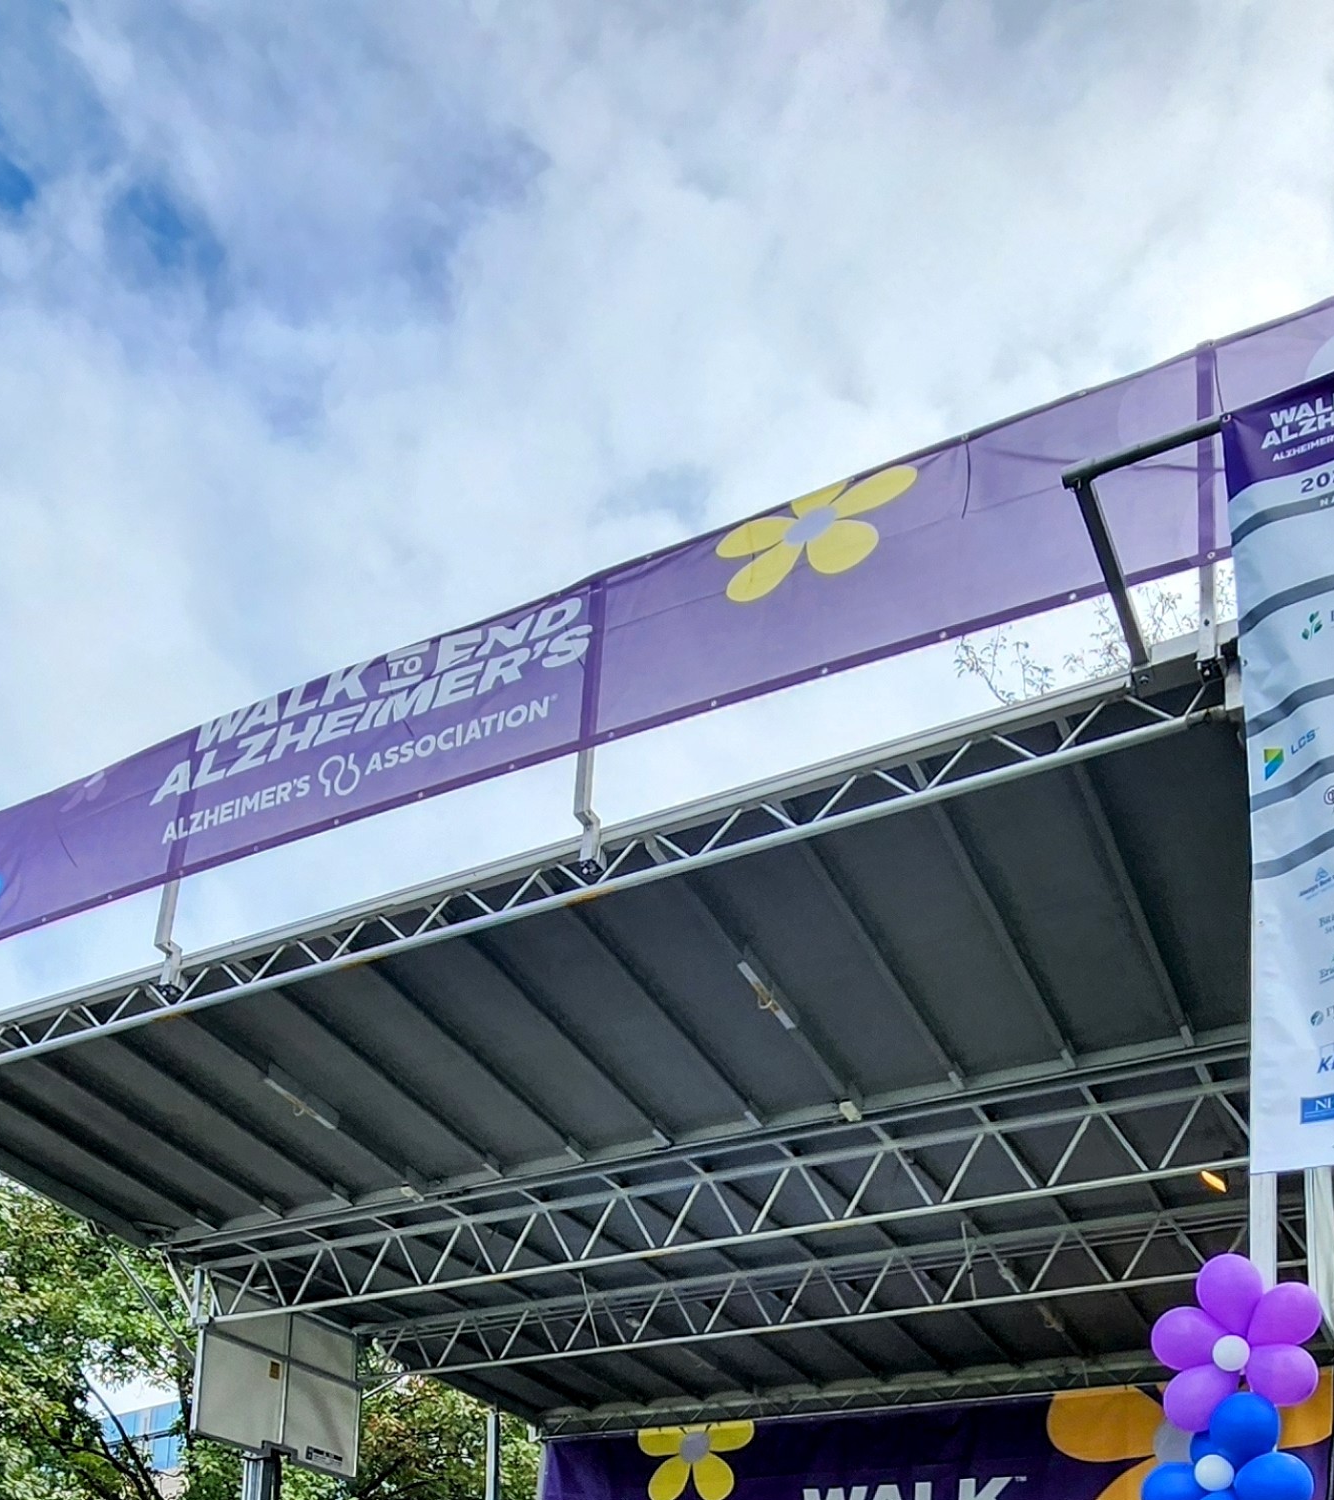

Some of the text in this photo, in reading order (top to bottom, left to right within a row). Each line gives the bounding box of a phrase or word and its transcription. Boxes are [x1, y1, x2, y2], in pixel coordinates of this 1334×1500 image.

[149, 624, 593, 807] ALZHEIMER'S
[196, 597, 583, 751] WALK END
[1290, 730, 1316, 755] LCS
[162, 695, 550, 845] ALZHEIMER'S ASSOCIATION
